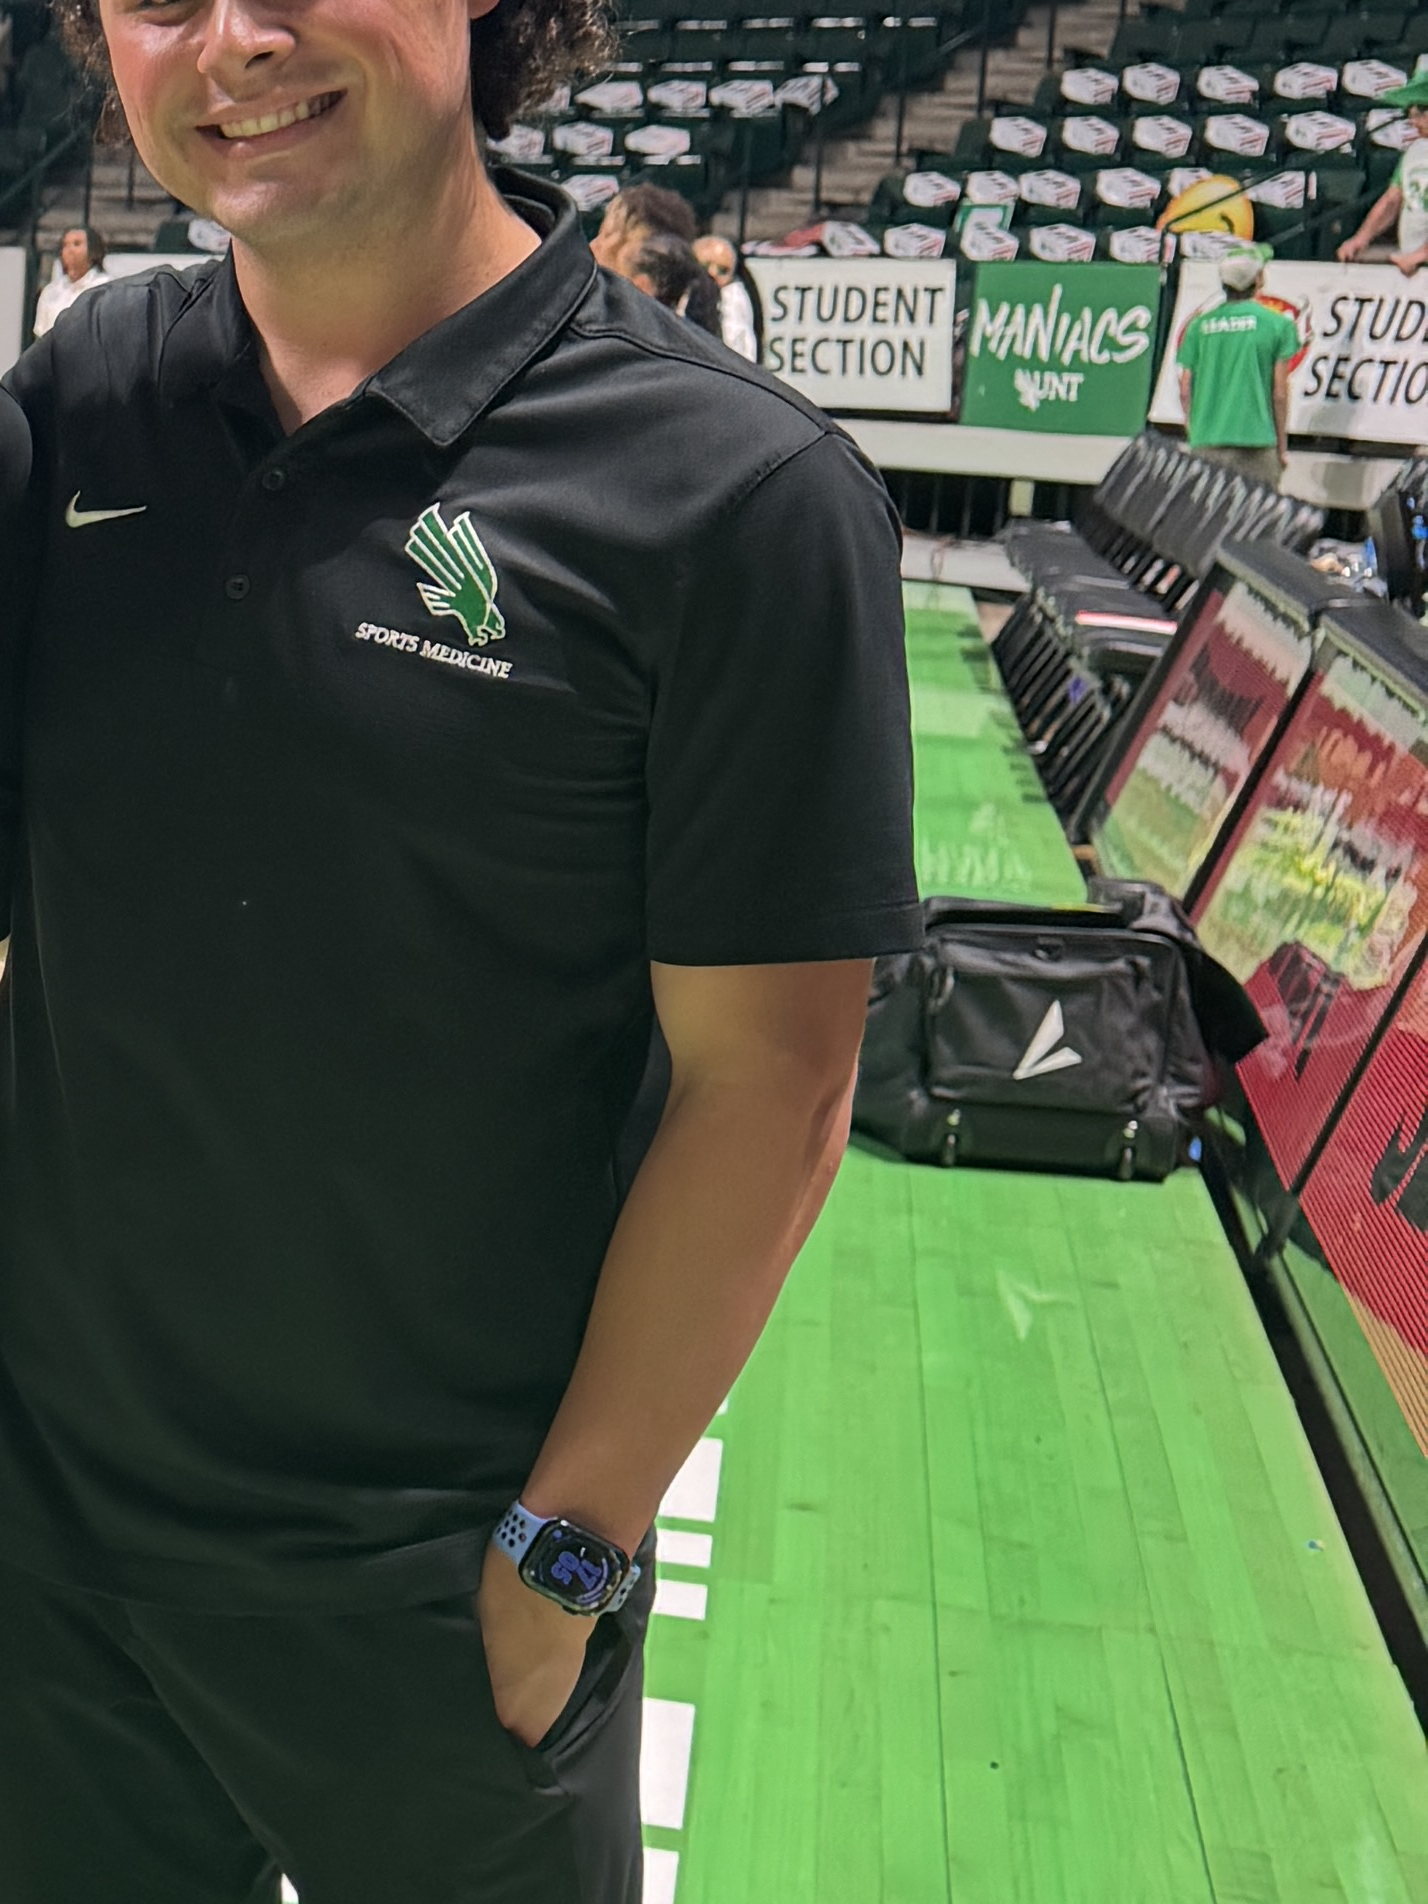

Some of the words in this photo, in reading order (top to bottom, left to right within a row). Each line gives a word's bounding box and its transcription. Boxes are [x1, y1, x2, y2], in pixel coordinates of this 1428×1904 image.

[770, 284, 945, 325] STUDENT
[969, 283, 1152, 367] MANIACS
[1323, 295, 1428, 344] STUD
[767, 336, 927, 378] SECTION
[1304, 355, 1428, 405] SECTIO
[1031, 370, 1085, 402] UNT
[354, 621, 421, 652] SPORTS
[419, 639, 514, 679] MEDICINE
